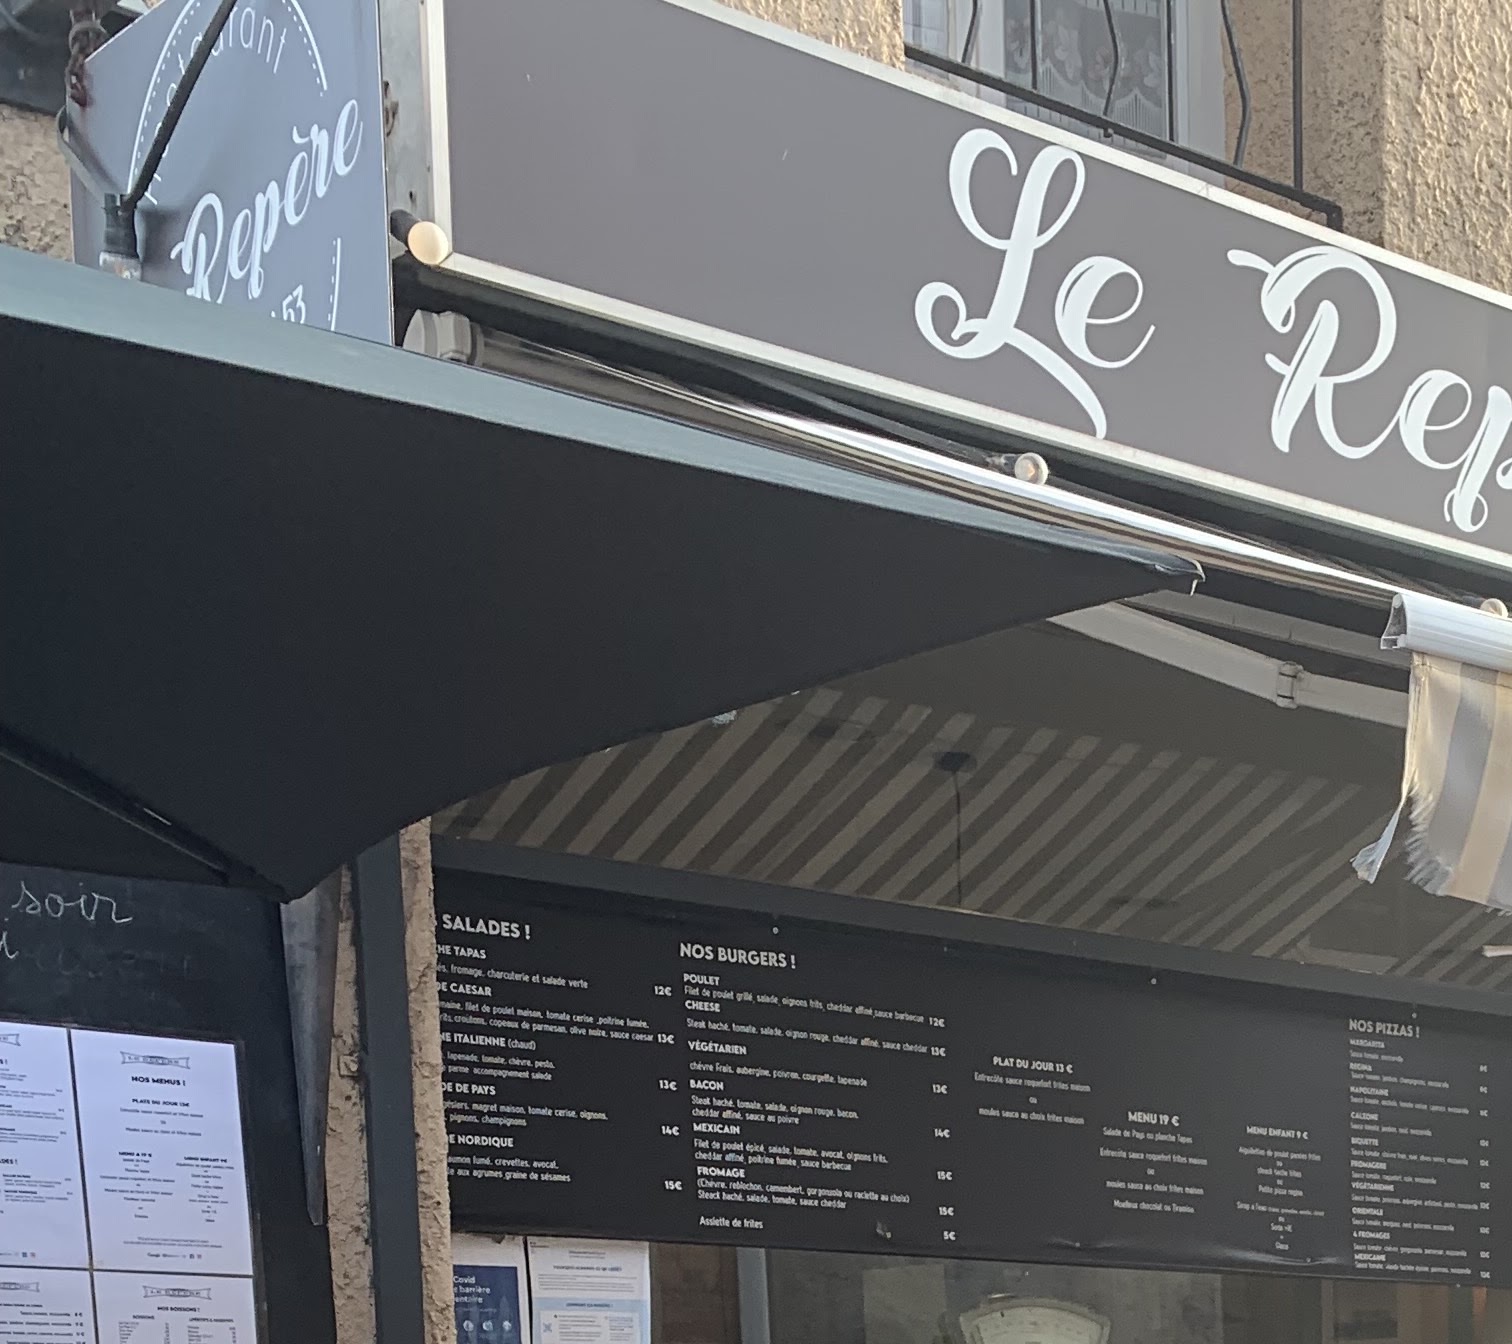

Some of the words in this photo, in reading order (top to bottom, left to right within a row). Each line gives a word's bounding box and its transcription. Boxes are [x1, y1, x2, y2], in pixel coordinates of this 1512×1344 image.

[170, 99, 363, 304] Repère
[914, 128, 1155, 440] Le
[11, 880, 133, 924] soir
[442, 914, 520, 937] SALADES
[524, 924, 530, 939] !
[454, 946, 486, 958] TAPAS
[679, 943, 714, 959] NOS
[717, 947, 787, 966] BURGERS
[790, 955, 795, 968] !
[486, 969, 529, 981] charcuterie
[531, 974, 540, 982] et
[541, 976, 566, 985] salade
[567, 979, 588, 988] verte
[683, 974, 719, 985] POULET
[450, 983, 491, 995] CAESAR
[654, 986, 671, 995] 12€
[684, 985, 699, 995] Filet
[701, 988, 710, 996] de
[712, 990, 734, 999] poulet
[480, 1004, 490, 1012] de
[492, 1006, 514, 1014] poulet
[684, 1001, 719, 1011] CHEESE
[686, 1018, 706, 1028] Steak
[928, 1017, 944, 1027] 12€
[1349, 1019, 1373, 1032] NOS
[1375, 1022, 1413, 1036] PIZZAS
[1415, 1026, 1419, 1037] !
[454, 1034, 505, 1046] ITALIENNE
[507, 1038, 536, 1049] (chaud)
[657, 1034, 674, 1043] 13€
[688, 1041, 746, 1054] VÉGÉTARIEN
[930, 1046, 945, 1056] 13€
[992, 1056, 1014, 1066] PLAT
[1015, 1058, 1029, 1068] DU
[1030, 1060, 1054, 1070] JOUR
[1055, 1063, 1064, 1072] 13
[1065, 1064, 1073, 1073] €
[455, 1083, 469, 1092] DE
[470, 1084, 496, 1094] PAYS
[659, 1080, 676, 1090] 13€
[690, 1079, 723, 1090] BACON
[932, 1084, 947, 1093] 13€
[1052, 1081, 1069, 1089] frites
[472, 1103, 497, 1112] magret
[527, 1106, 552, 1115] tomate
[1128, 1112, 1157, 1123] MENU
[1158, 1114, 1169, 1124] 19
[1170, 1115, 1179, 1126] €
[661, 1125, 679, 1135] 14€
[693, 1123, 739, 1133] MEXICAIN
[934, 1128, 949, 1137] 14€
[1246, 1126, 1267, 1134] MENU
[1268, 1128, 1295, 1137] ENFANT
[458, 1136, 513, 1147] NORDIQUE
[697, 1166, 744, 1177] FROMAGE
[937, 1171, 952, 1180] 15€
[664, 1181, 682, 1190] 15€
[938, 1206, 953, 1215] 15€
[699, 1216, 730, 1226] Assiette
[731, 1218, 741, 1227] de
[743, 1218, 763, 1228] frites
[943, 1231, 955, 1240] 5€
[453, 1275, 476, 1284] Covid
[459, 1285, 491, 1295] barrière
